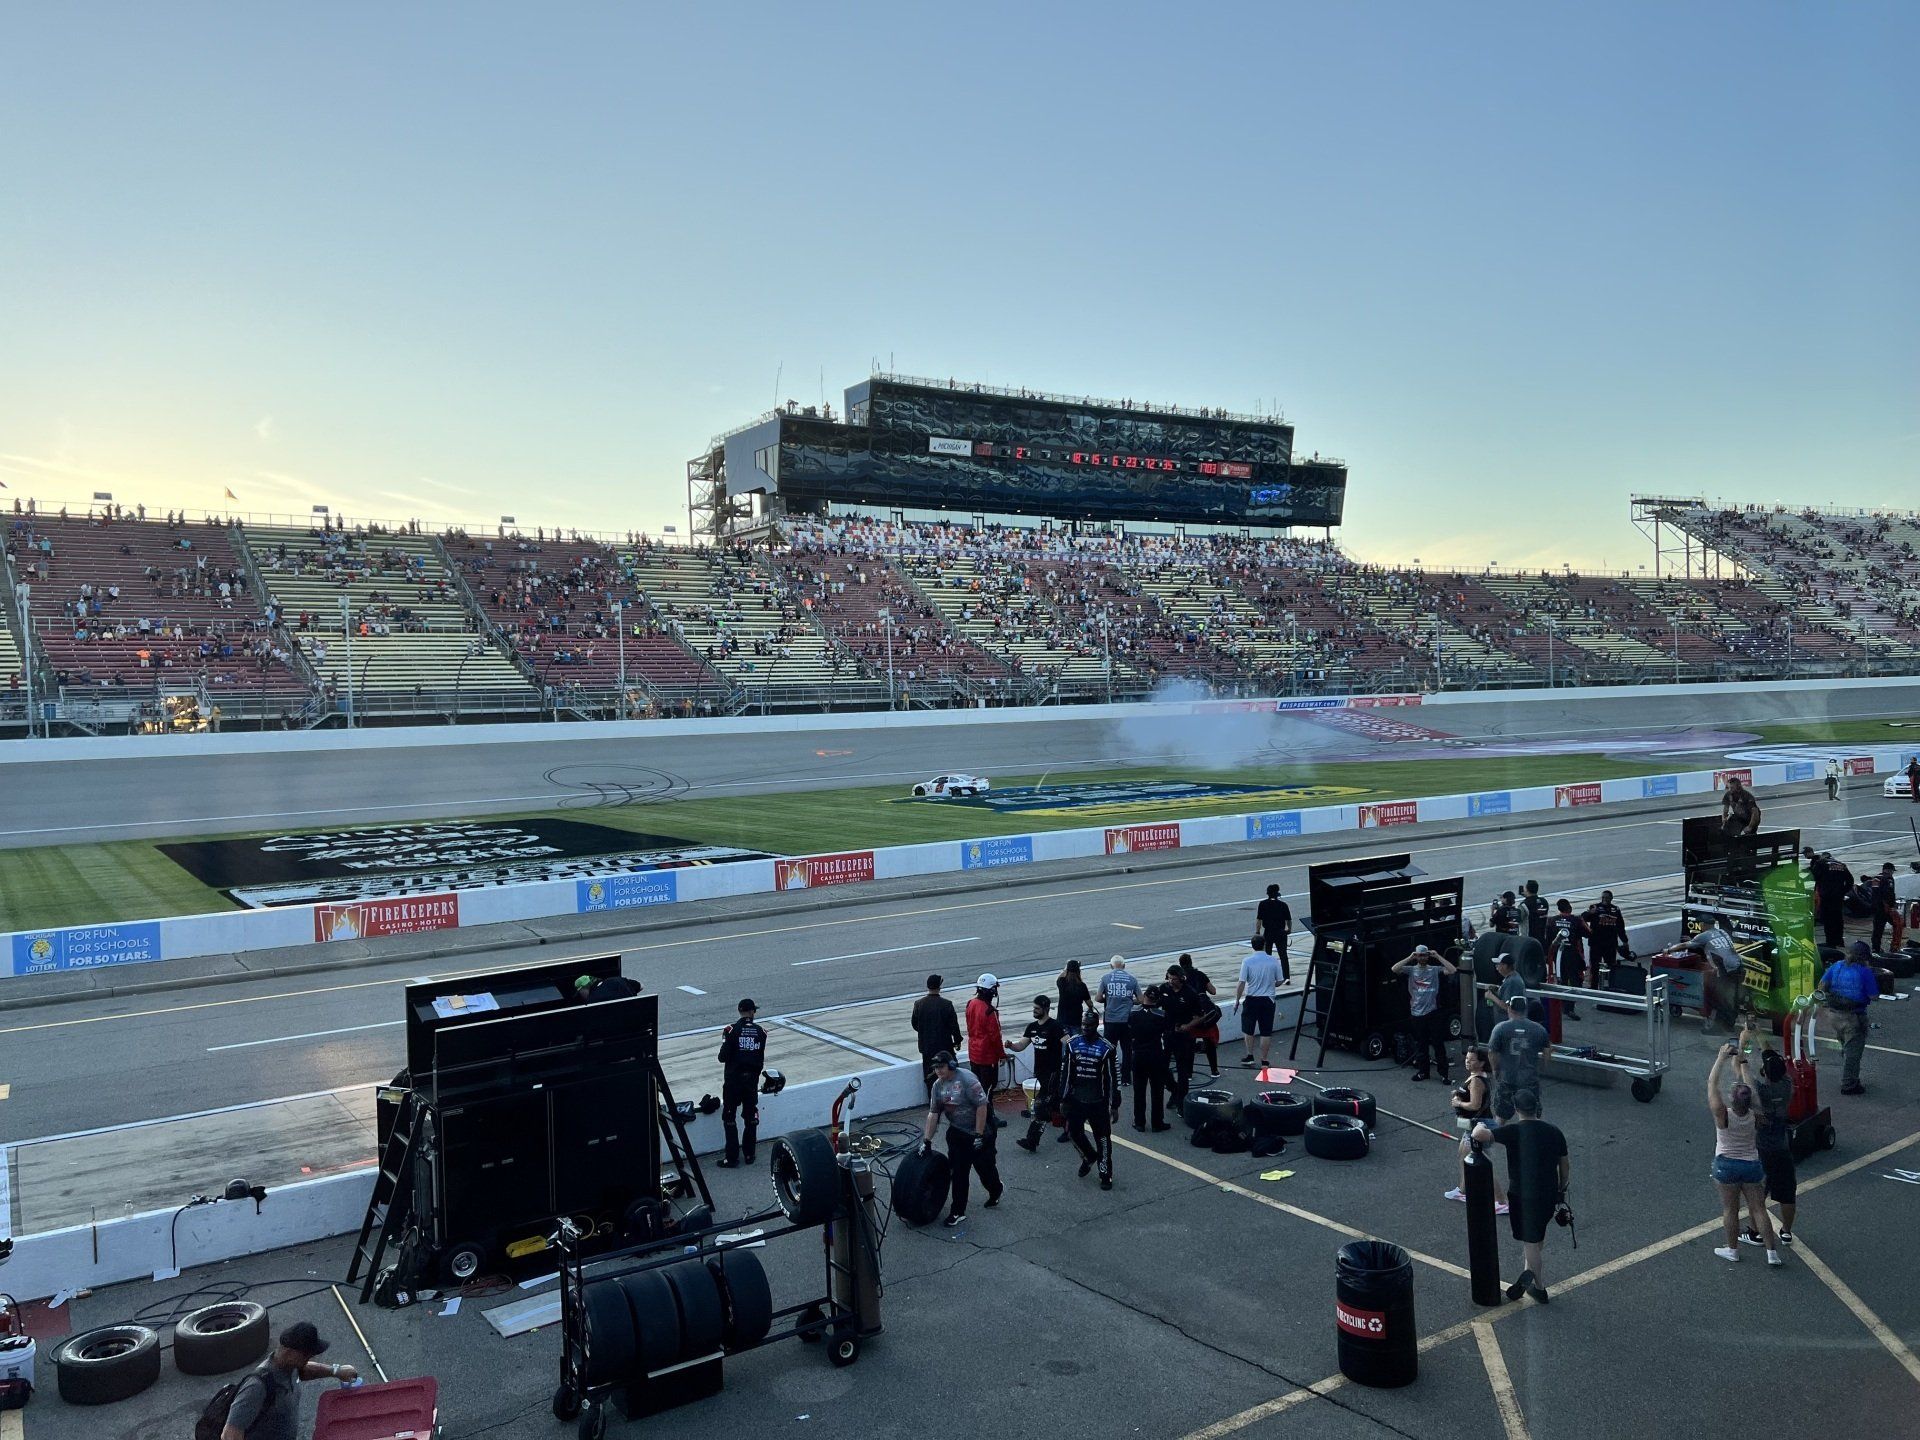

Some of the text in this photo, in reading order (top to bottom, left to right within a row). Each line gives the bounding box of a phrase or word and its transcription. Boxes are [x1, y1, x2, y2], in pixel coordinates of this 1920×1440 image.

[1112, 456, 1119, 467] 6
[1126, 457, 1137, 468] 23
[1134, 829, 1178, 842] FIREKEEPERS
[814, 857, 873, 875] FIREKEEPERS
[614, 877, 630, 886] FOR
[820, 873, 844, 882] CASINO
[632, 883, 671, 894] SCHOOLS.
[615, 898, 631, 907] FOR
[643, 894, 671, 903] YEARS.
[371, 901, 455, 922] FIREKEEPERS
[379, 918, 446, 930] CASINO HOTEL
[68, 928, 120, 942] FOR FUN.
[69, 938, 152, 954] FOR SCHOOLS.
[69, 950, 152, 967] FOR 50 YEARS.
[25, 963, 57, 973] LOTTERY
[1107, 982, 1127, 990] max
[1339, 1309, 1366, 1330] RECYCLING
